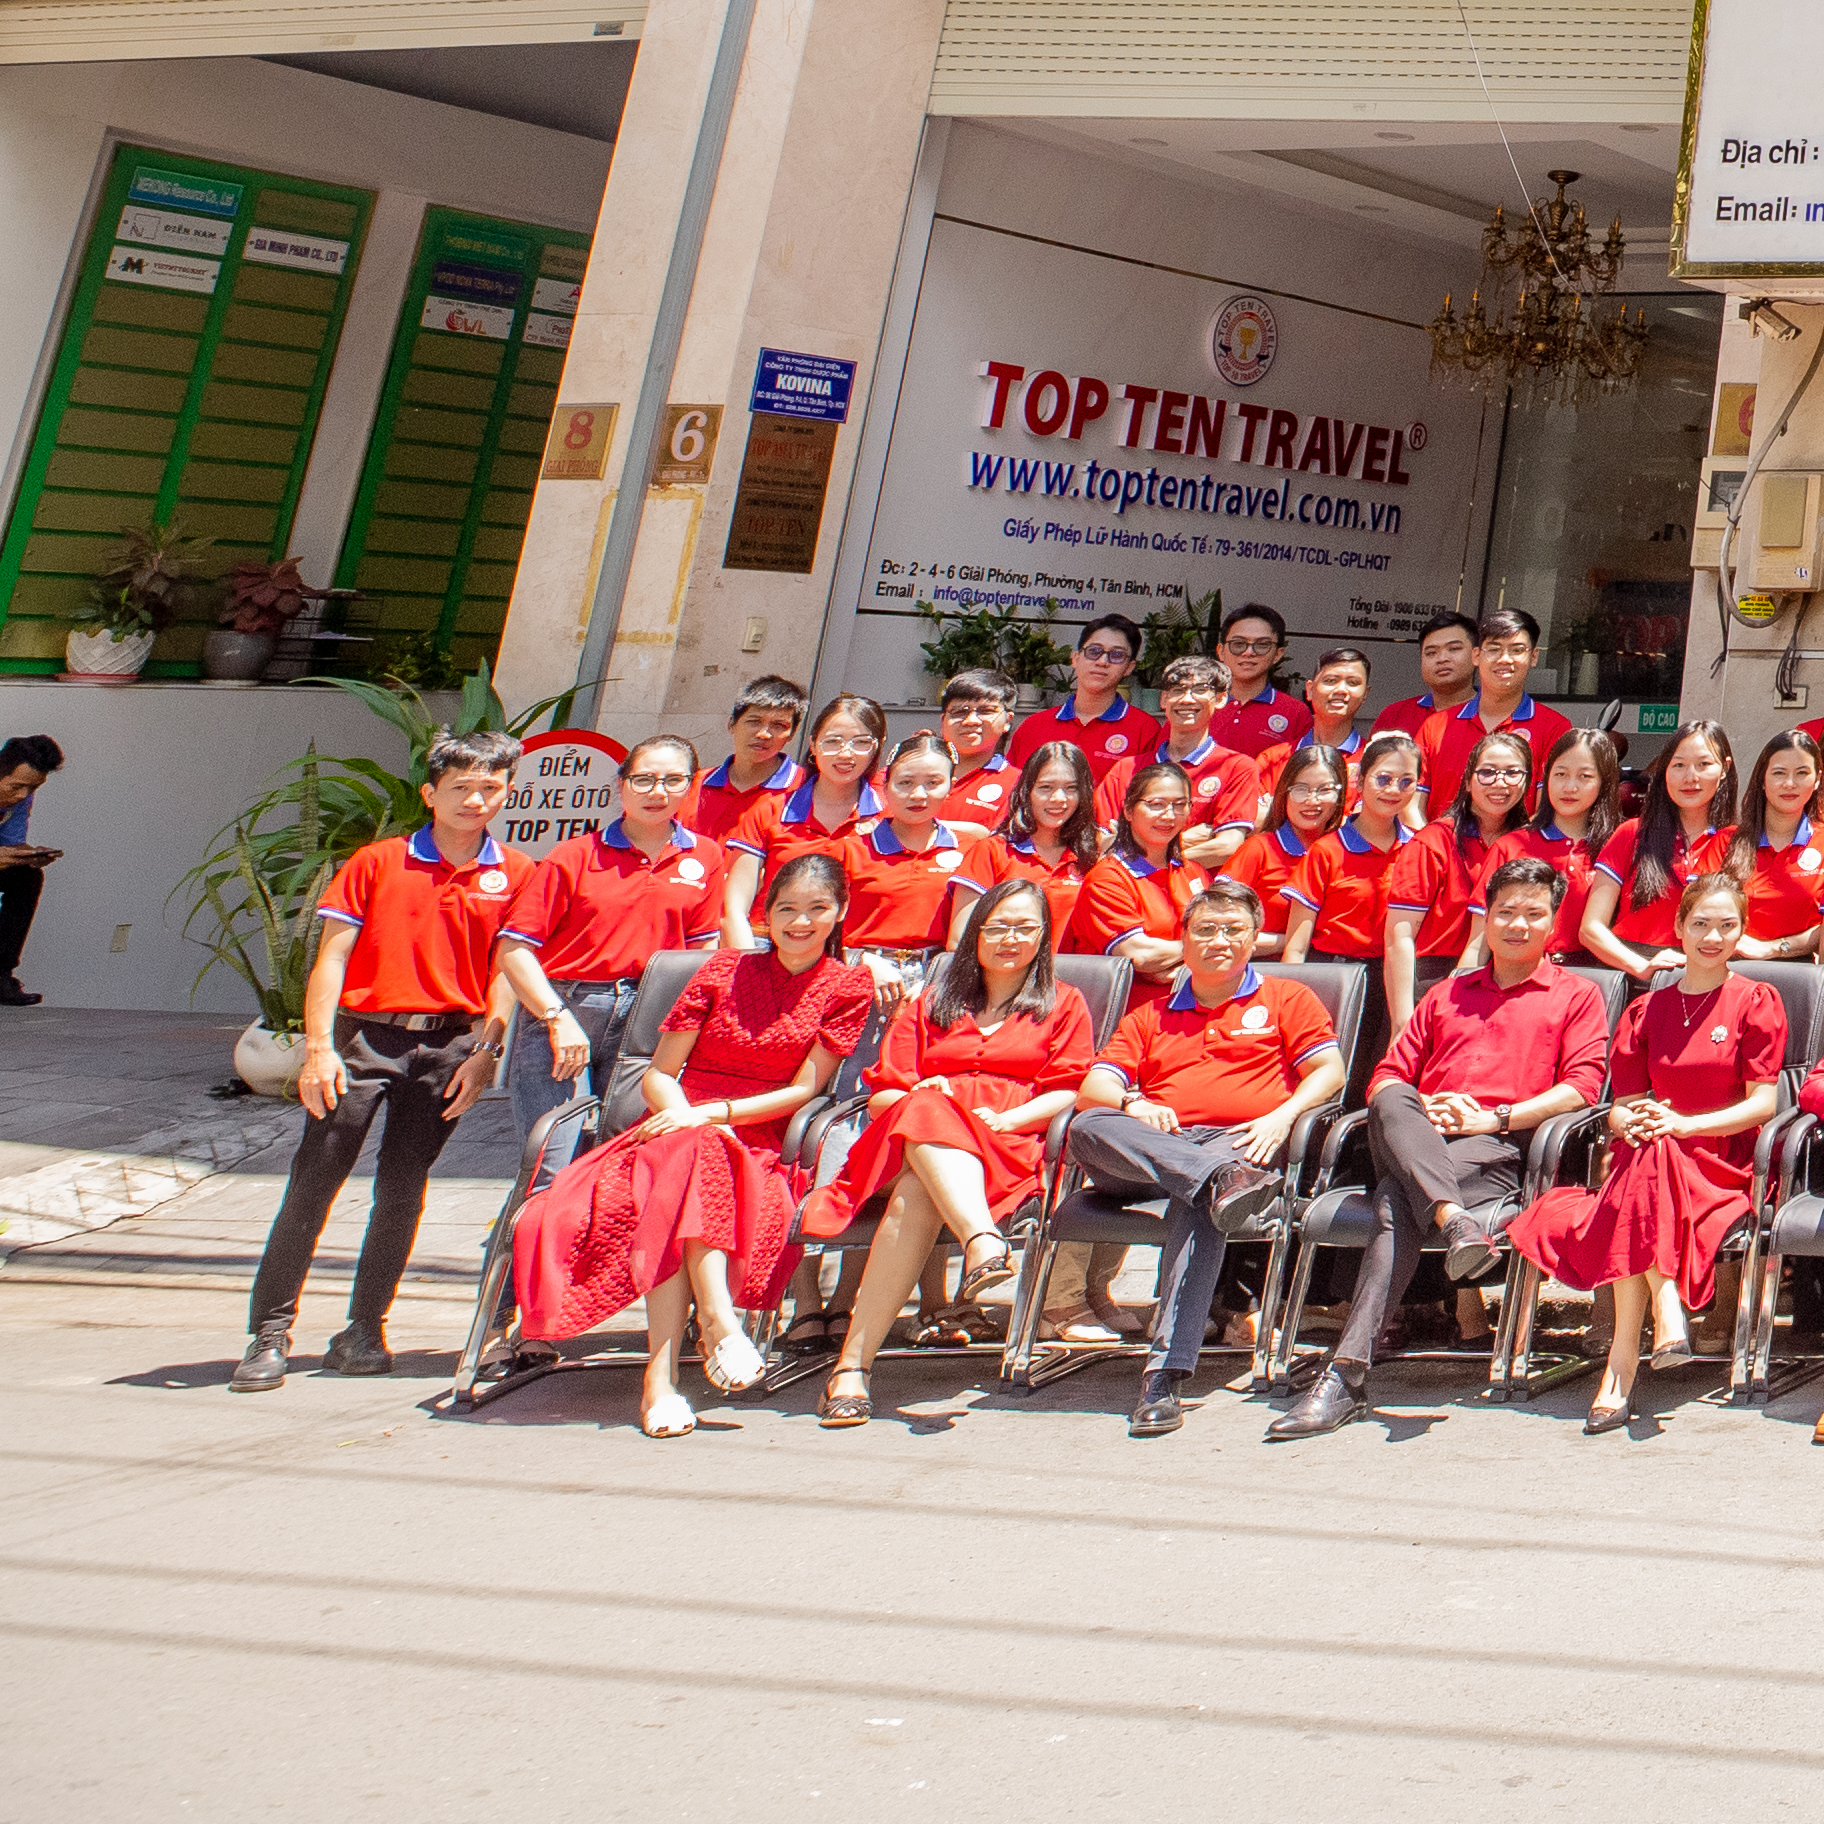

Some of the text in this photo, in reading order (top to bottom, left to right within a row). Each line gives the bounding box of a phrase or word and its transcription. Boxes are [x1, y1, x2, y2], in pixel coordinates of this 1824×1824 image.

[1720, 139, 1762, 170] Địa
[1715, 196, 1798, 223] Email:
[775, 373, 833, 396] KOVINA
[983, 360, 1109, 440] TOP
[1121, 383, 1228, 459] TEN
[564, 410, 595, 450] 8
[671, 410, 708, 462] 6
[968, 451, 1401, 534] www.toptentravel.com.vn
[1003, 517, 1041, 544] Giấy
[1043, 521, 1083, 547] Phép
[1110, 528, 1149, 551] Hành
[1151, 531, 1188, 555] Quốc
[538, 748, 591, 777] ĐIỂM
[537, 788, 567, 810] XE
[571, 784, 612, 809] ÔTÔ
[505, 818, 601, 843] TOP TEN
